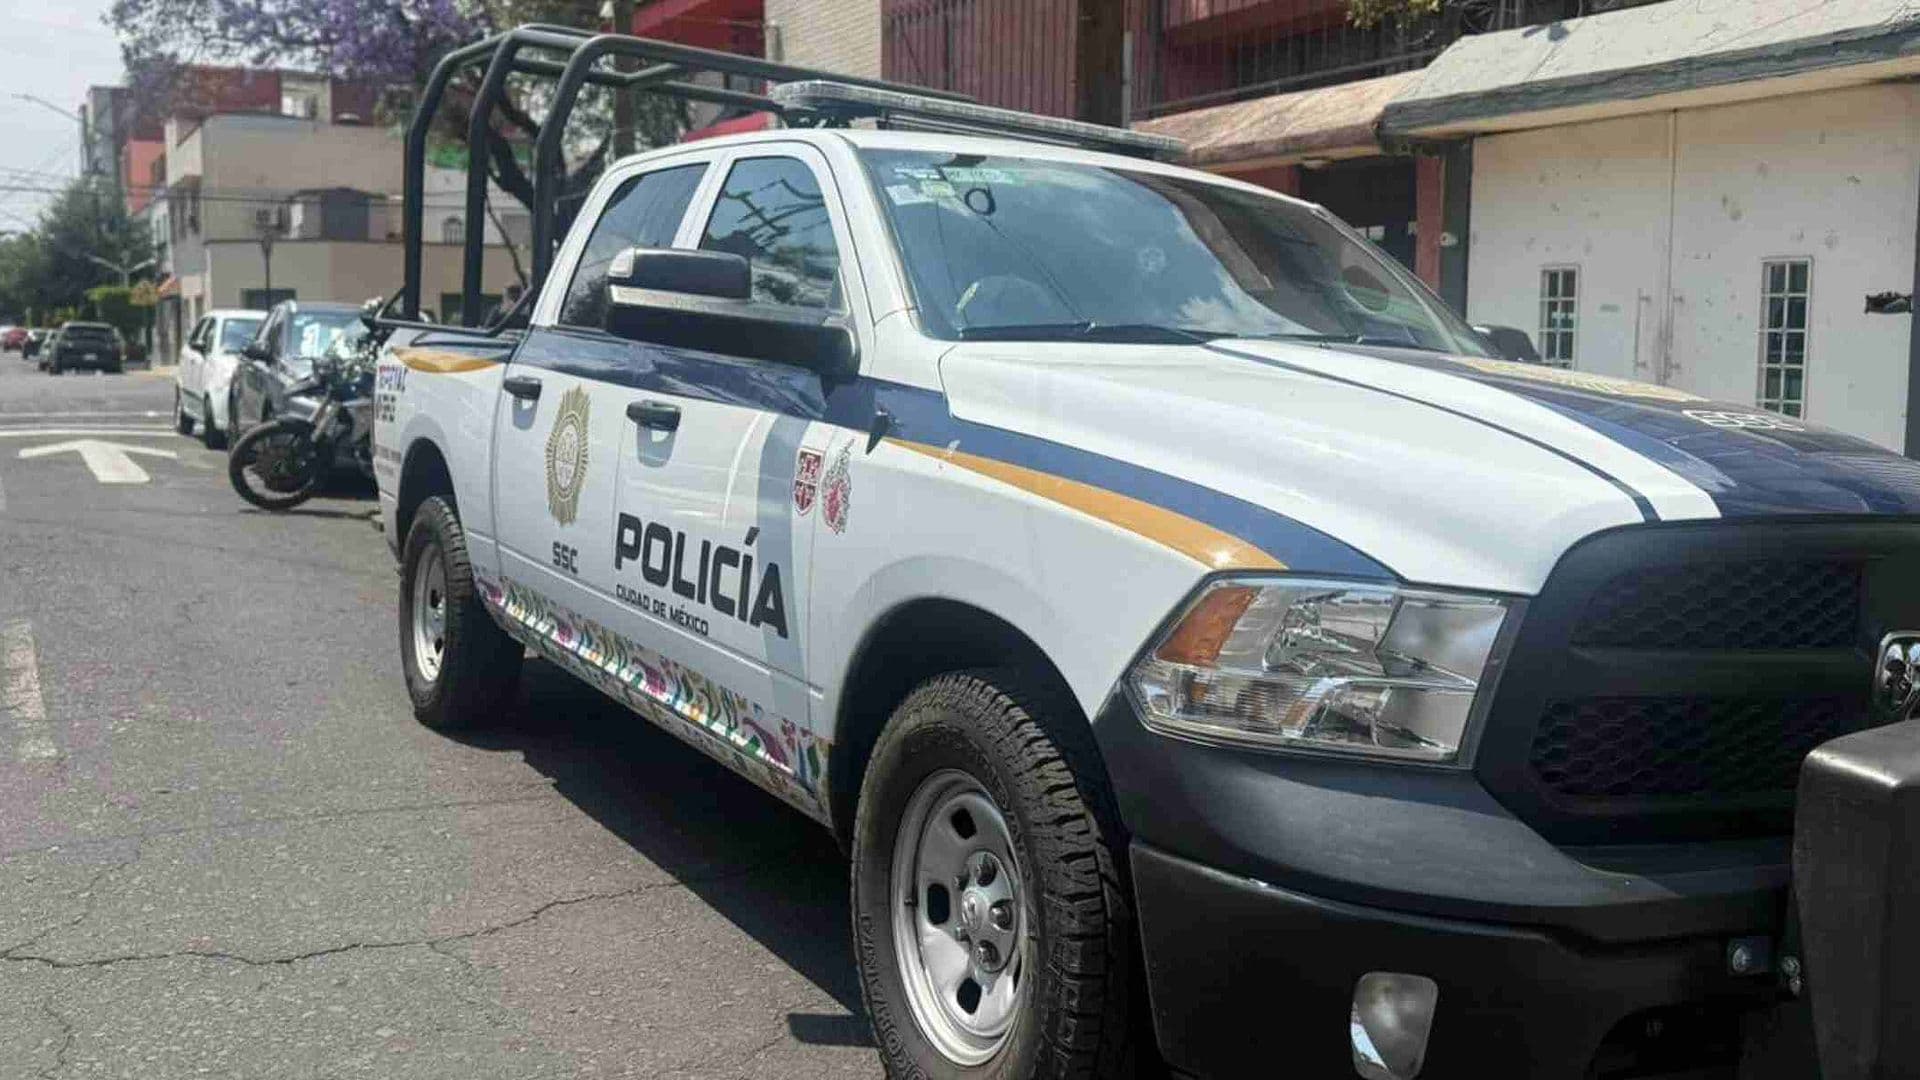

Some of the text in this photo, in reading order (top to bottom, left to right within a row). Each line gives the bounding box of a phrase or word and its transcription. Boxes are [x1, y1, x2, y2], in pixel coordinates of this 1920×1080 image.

[552, 541, 579, 575] SSC
[614, 512, 788, 639] POLICÍA
[616, 584, 709, 636] CIUDAD DE MÉXICO
